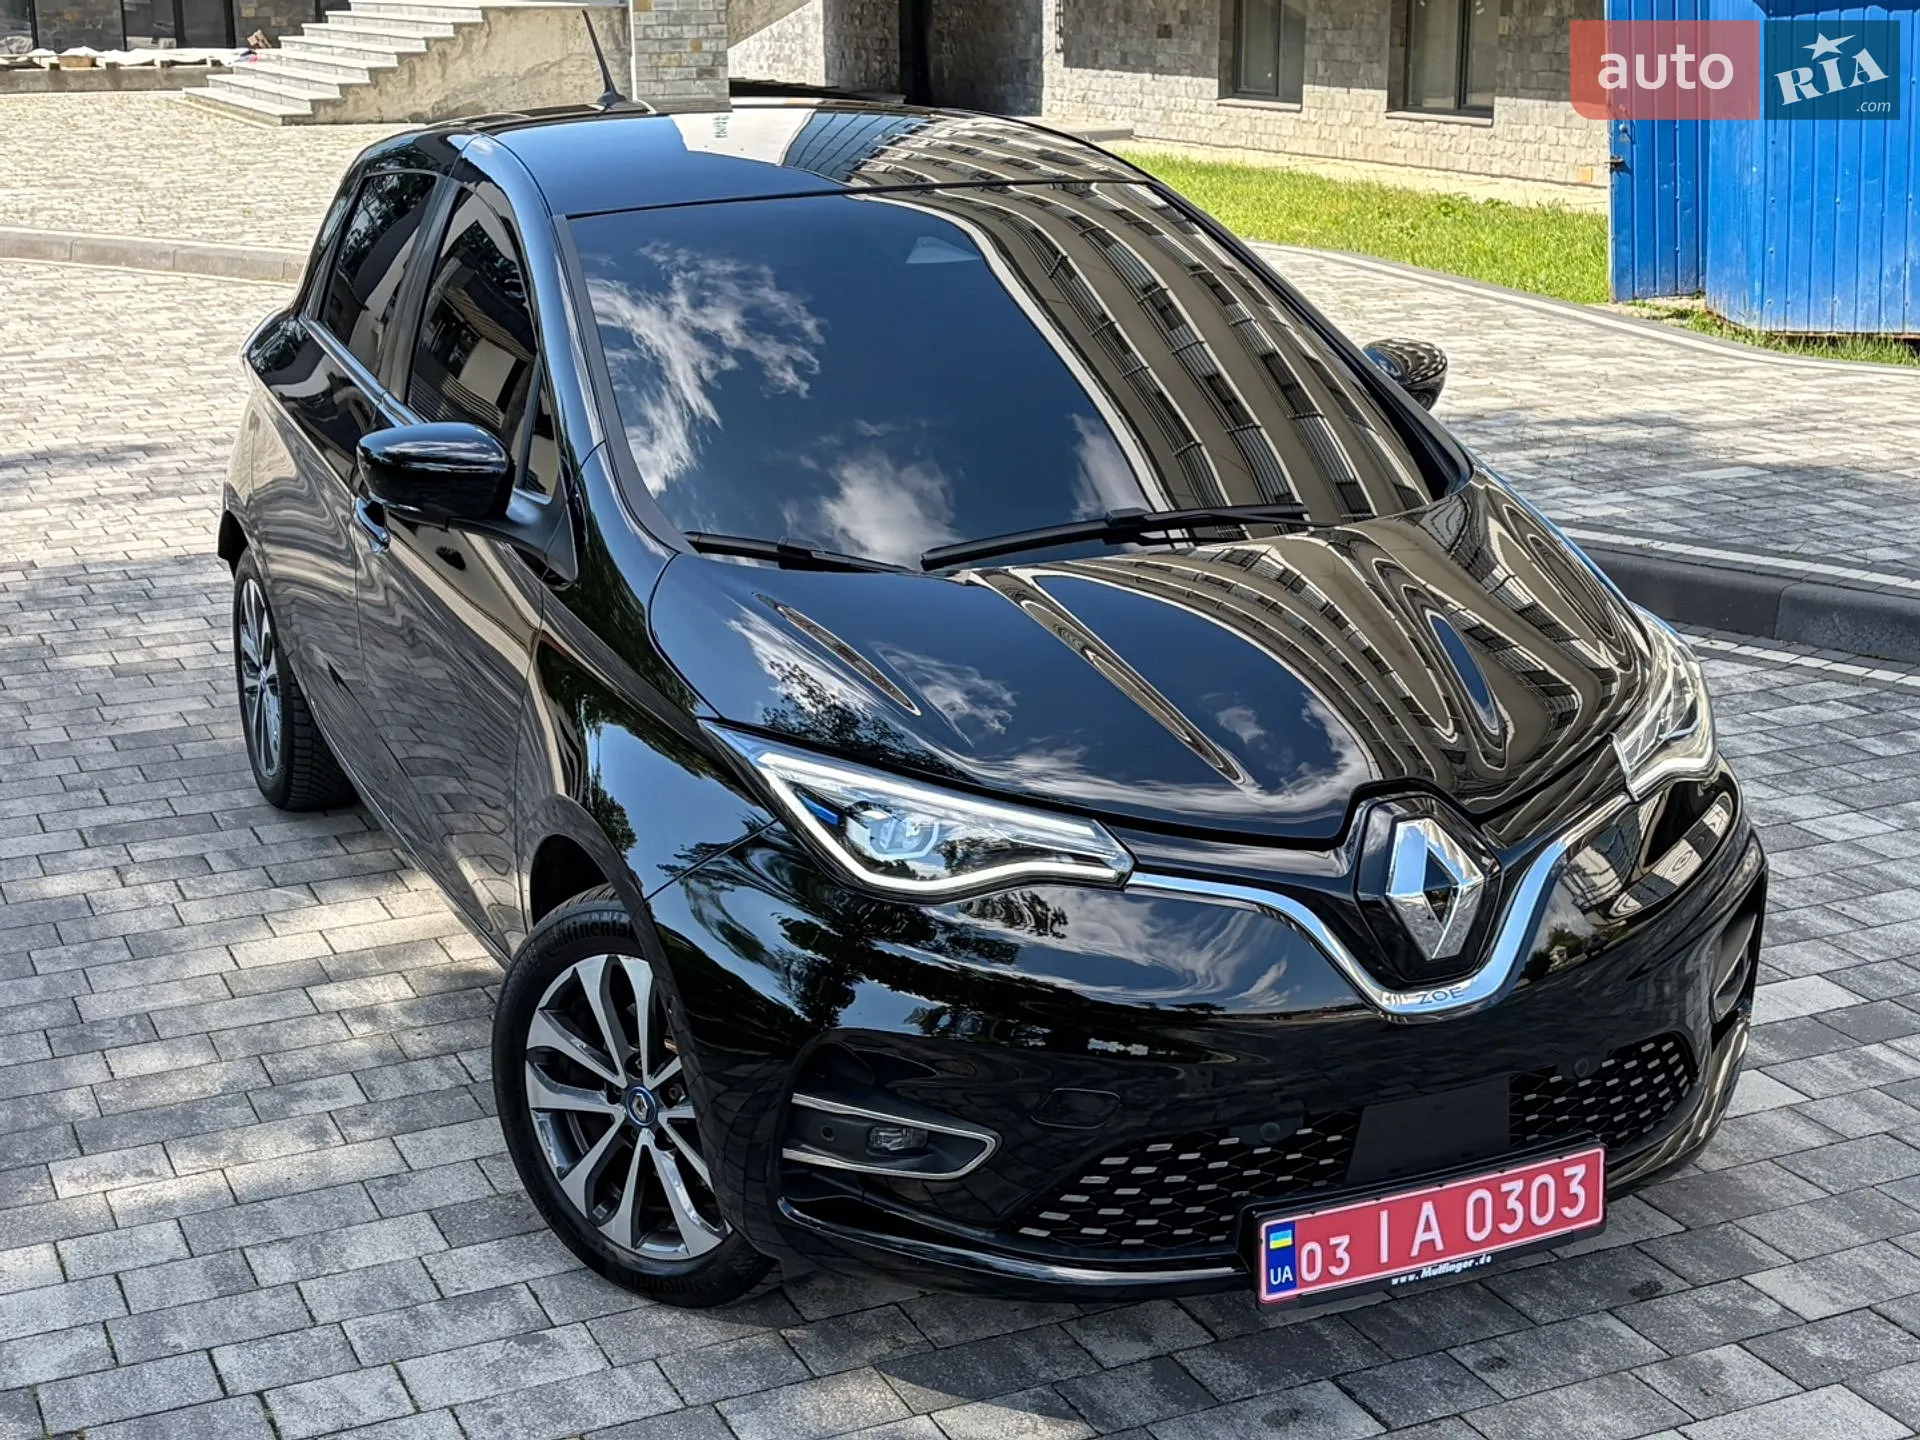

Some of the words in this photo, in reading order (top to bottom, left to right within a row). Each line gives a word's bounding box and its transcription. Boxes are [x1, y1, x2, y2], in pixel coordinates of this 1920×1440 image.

[1416, 987, 1465, 1005] ZOE
[1301, 1234, 1351, 1282] 03
[1379, 1201, 1445, 1264] IA
[1465, 1163, 1587, 1244] 0303
[1270, 1266, 1294, 1286] UA
